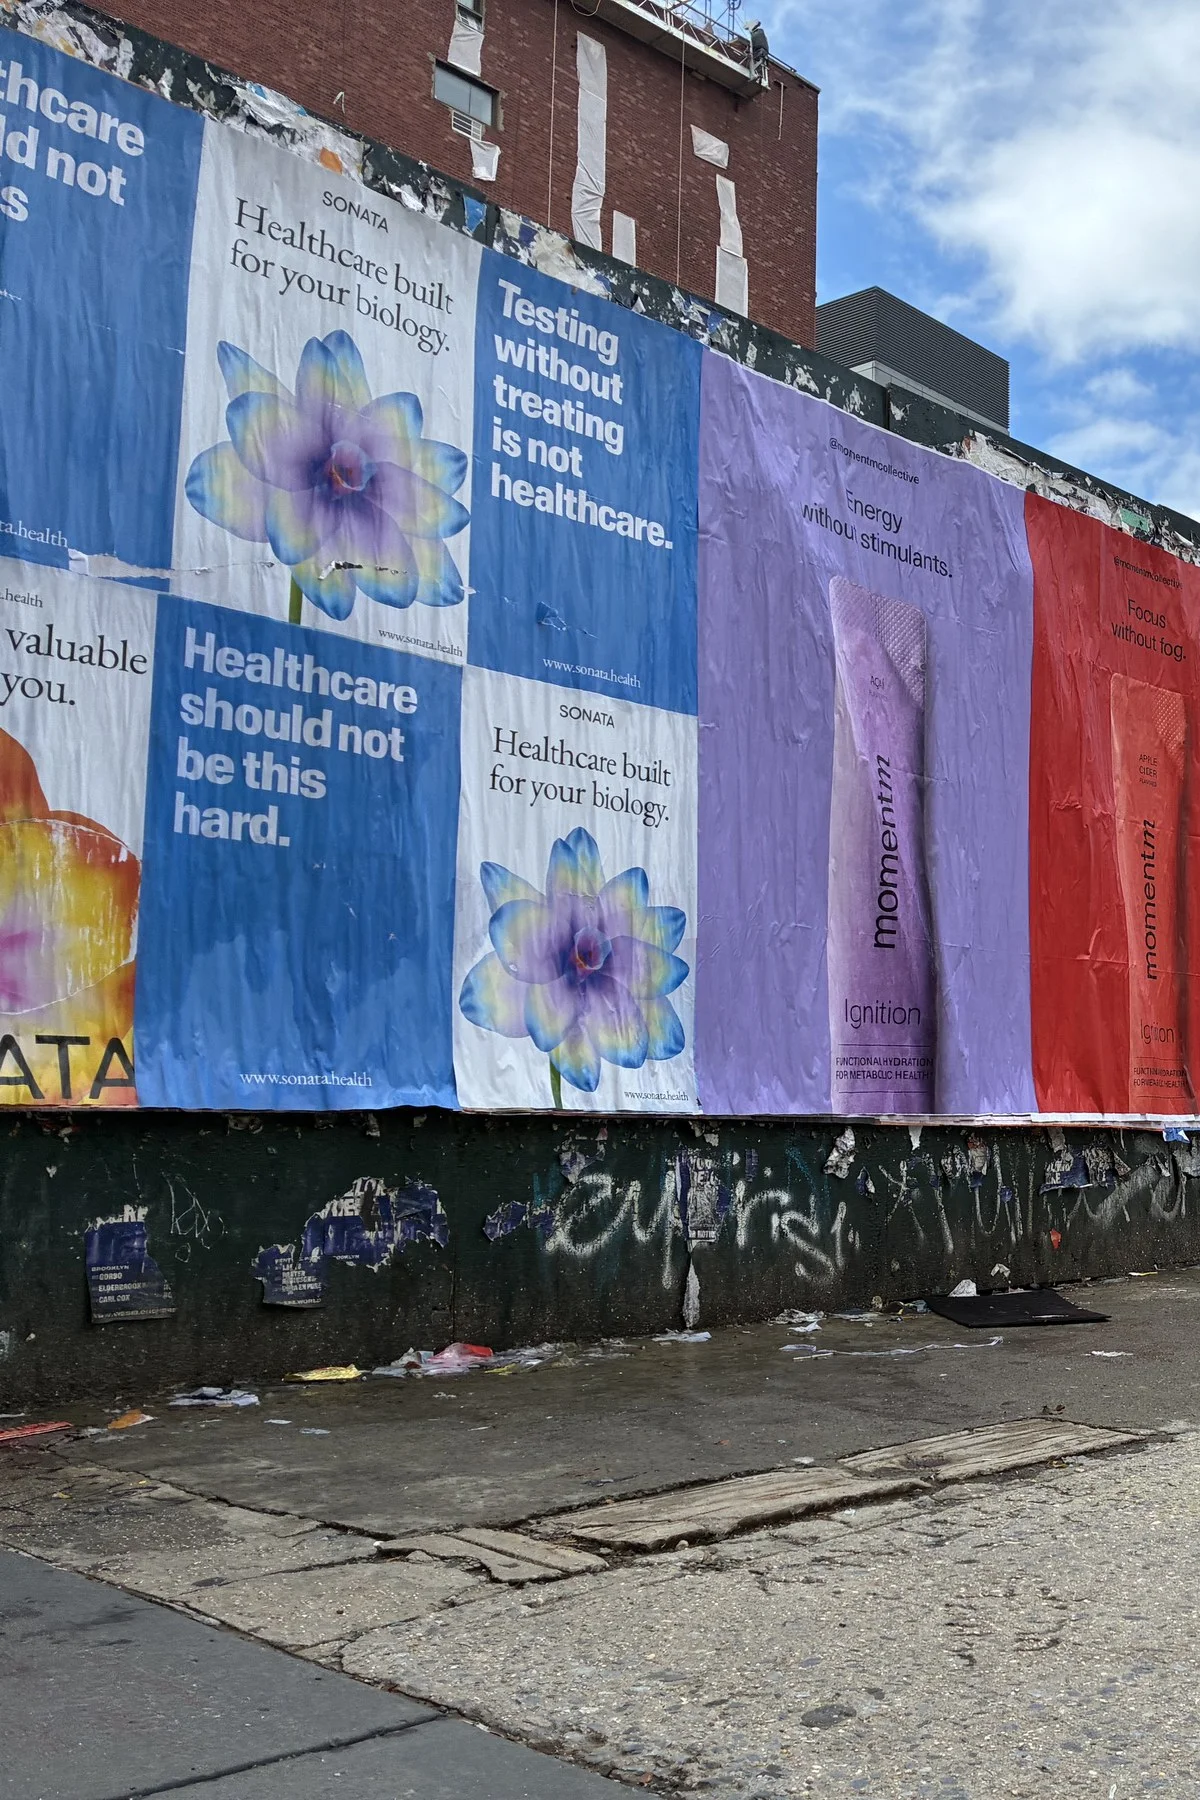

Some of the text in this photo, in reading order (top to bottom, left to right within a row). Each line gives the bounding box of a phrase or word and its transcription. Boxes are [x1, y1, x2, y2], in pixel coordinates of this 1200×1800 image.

[46, 146, 127, 206] not
[322, 191, 389, 233] SONATA
[235, 197, 454, 315] Healthcare built
[230, 238, 450, 356] for your biology.
[498, 278, 619, 367] Testing
[494, 334, 623, 405] without
[493, 374, 624, 456] treating
[492, 416, 583, 479] is not
[491, 462, 674, 550] healthcare.
[845, 488, 903, 534] Energy
[861, 533, 953, 578] stimulants.
[1111, 622, 1187, 662] without fog.
[1128, 599, 1166, 629] Focus
[5, 624, 148, 675] valuable
[184, 626, 418, 714] Healthcare
[378, 629, 463, 657] www.sonata.health
[0, 672, 76, 707] you.
[543, 658, 641, 689] www.sonata.health
[180, 692, 405, 762] should not
[559, 705, 615, 728] SONATA
[177, 736, 327, 799] be this
[493, 726, 671, 786] Healthcare built
[173, 791, 291, 847] hard.
[489, 763, 669, 829] for your biology.
[844, 998, 921, 1029] Ignition
[239, 1071, 373, 1088] www.sonata.health
[836, 1070, 849, 1080] FOR
